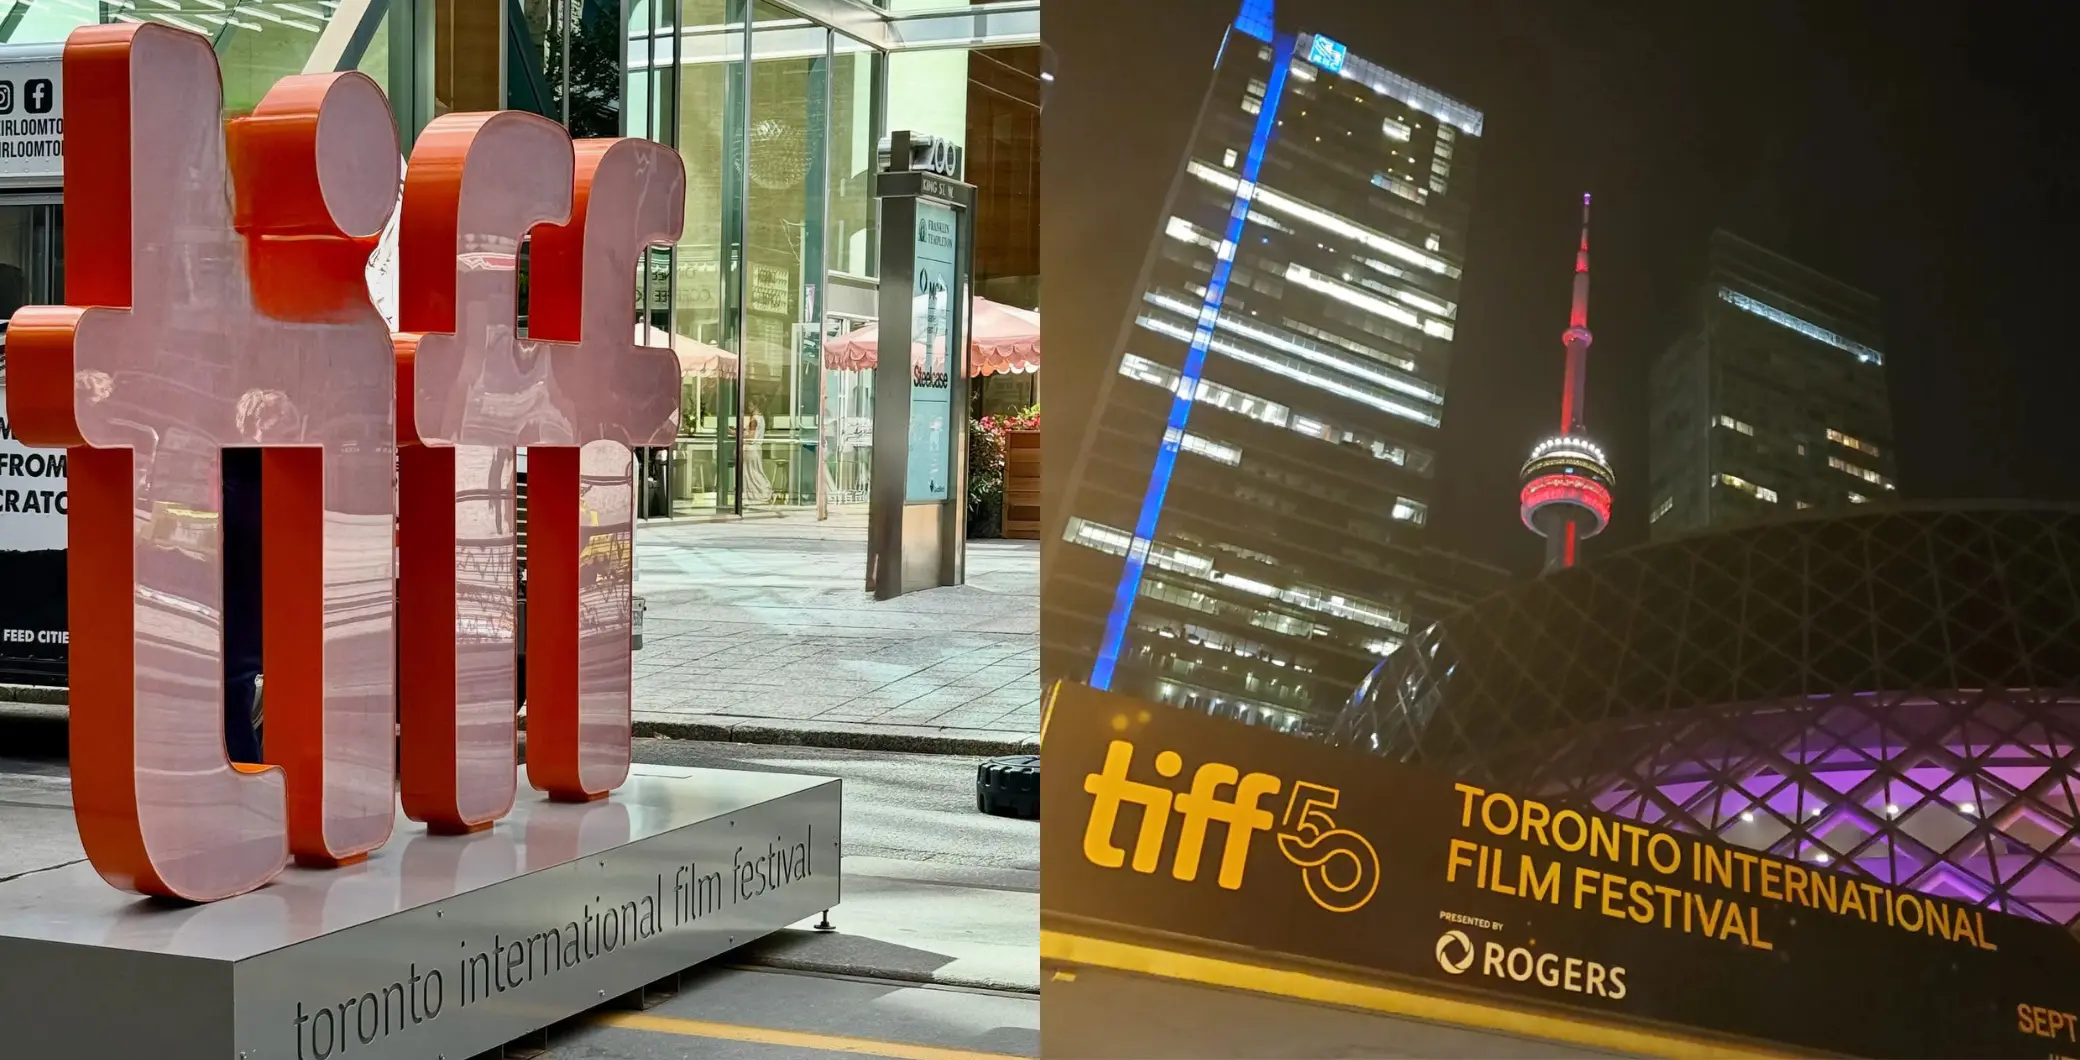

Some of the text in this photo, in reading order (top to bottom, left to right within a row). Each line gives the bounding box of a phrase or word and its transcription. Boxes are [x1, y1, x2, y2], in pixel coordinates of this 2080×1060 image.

[0, 118, 63, 136] IRLOOMTO
[923, 179, 938, 194] KING
[914, 364, 949, 389] Steelcase
[0, 453, 67, 478] FROM
[7, 22, 686, 904] tiff
[0, 489, 68, 515] RATC
[3, 628, 35, 643] FEED
[1084, 740, 1380, 913] tiff 50
[1453, 783, 1998, 951] TORONTO INTERNATIONAL
[1447, 839, 1773, 951] FILM FESTIVAL
[1439, 910, 1504, 931] PRESENTED BY
[294, 825, 812, 1060] toronto international film festival
[1483, 941, 1627, 999] ROGERS
[2017, 1003, 2077, 1043] SEPT
